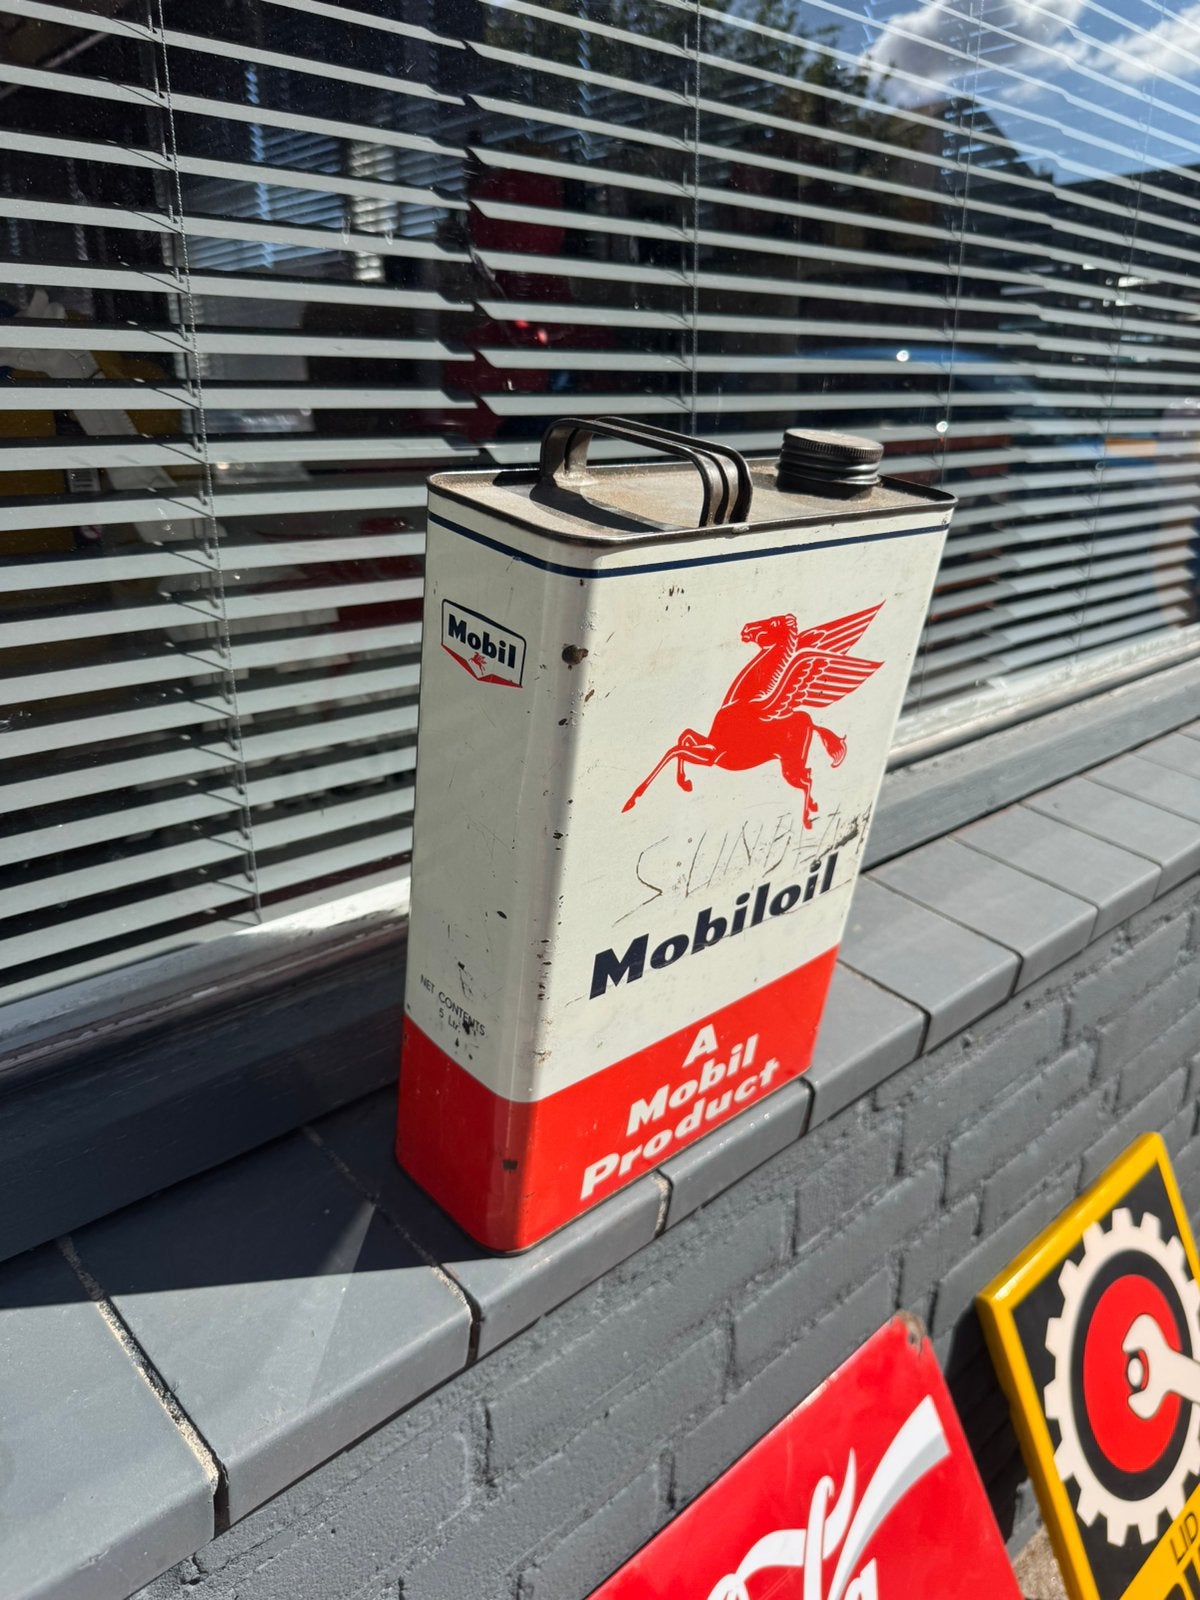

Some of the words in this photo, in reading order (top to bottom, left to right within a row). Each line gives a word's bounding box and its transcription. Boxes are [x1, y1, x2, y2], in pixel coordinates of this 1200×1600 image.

[448, 613, 517, 670] Mobil
[589, 851, 839, 1001] Mobiloil
[420, 974, 436, 994] NET
[438, 990, 487, 1037] CONTENTS
[438, 1007, 445, 1019] 5
[681, 1023, 719, 1069] A
[625, 1032, 759, 1137] Mobil
[579, 1056, 780, 1201] Product
